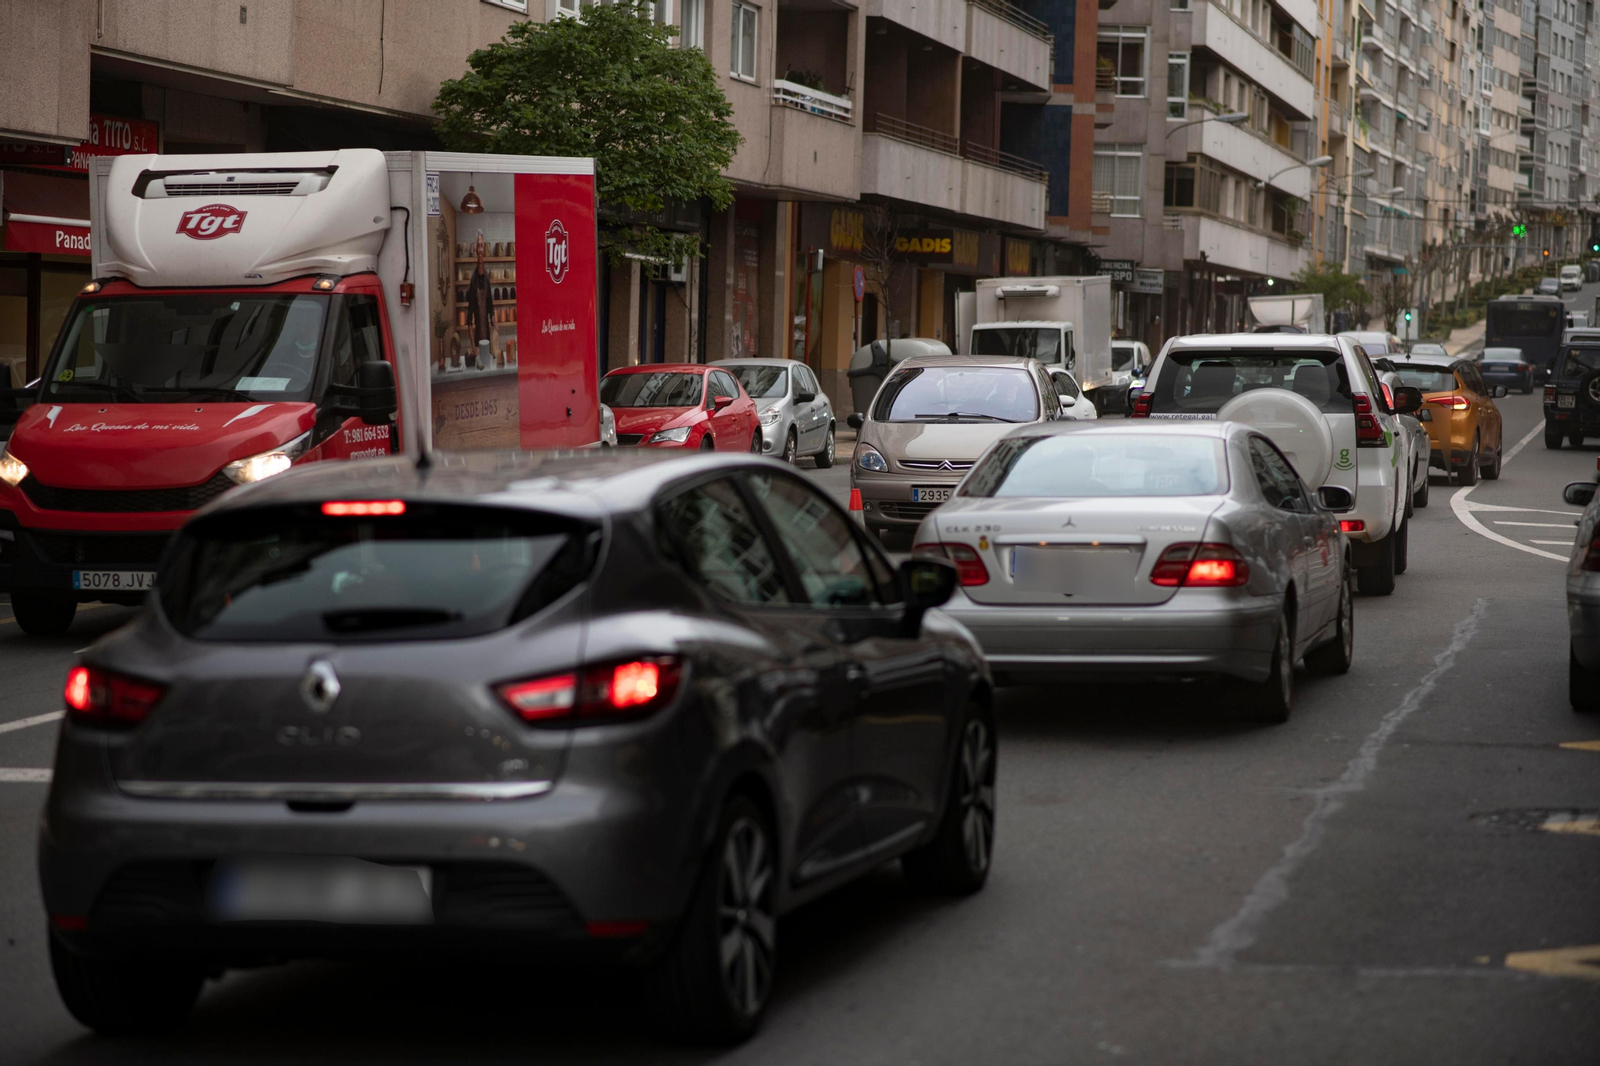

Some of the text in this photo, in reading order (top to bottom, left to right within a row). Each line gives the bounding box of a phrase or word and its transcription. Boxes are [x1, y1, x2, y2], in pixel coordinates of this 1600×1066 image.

[104, 119, 132, 150] TITO
[186, 212, 240, 236] Tgt
[895, 237, 952, 254] GADIS
[547, 237, 567, 275] Tgt
[454, 399, 498, 421] DESDE 1963
[1150, 413, 1214, 421] www.retegal.gal
[133, 422, 150, 431] de
[172, 423, 200, 431] vida
[352, 428, 363, 443] 981
[364, 426, 376, 441] 664
[920, 490, 950, 501] 2935
[83, 573, 121, 588] 5078
[276, 725, 363, 747] CLIO
